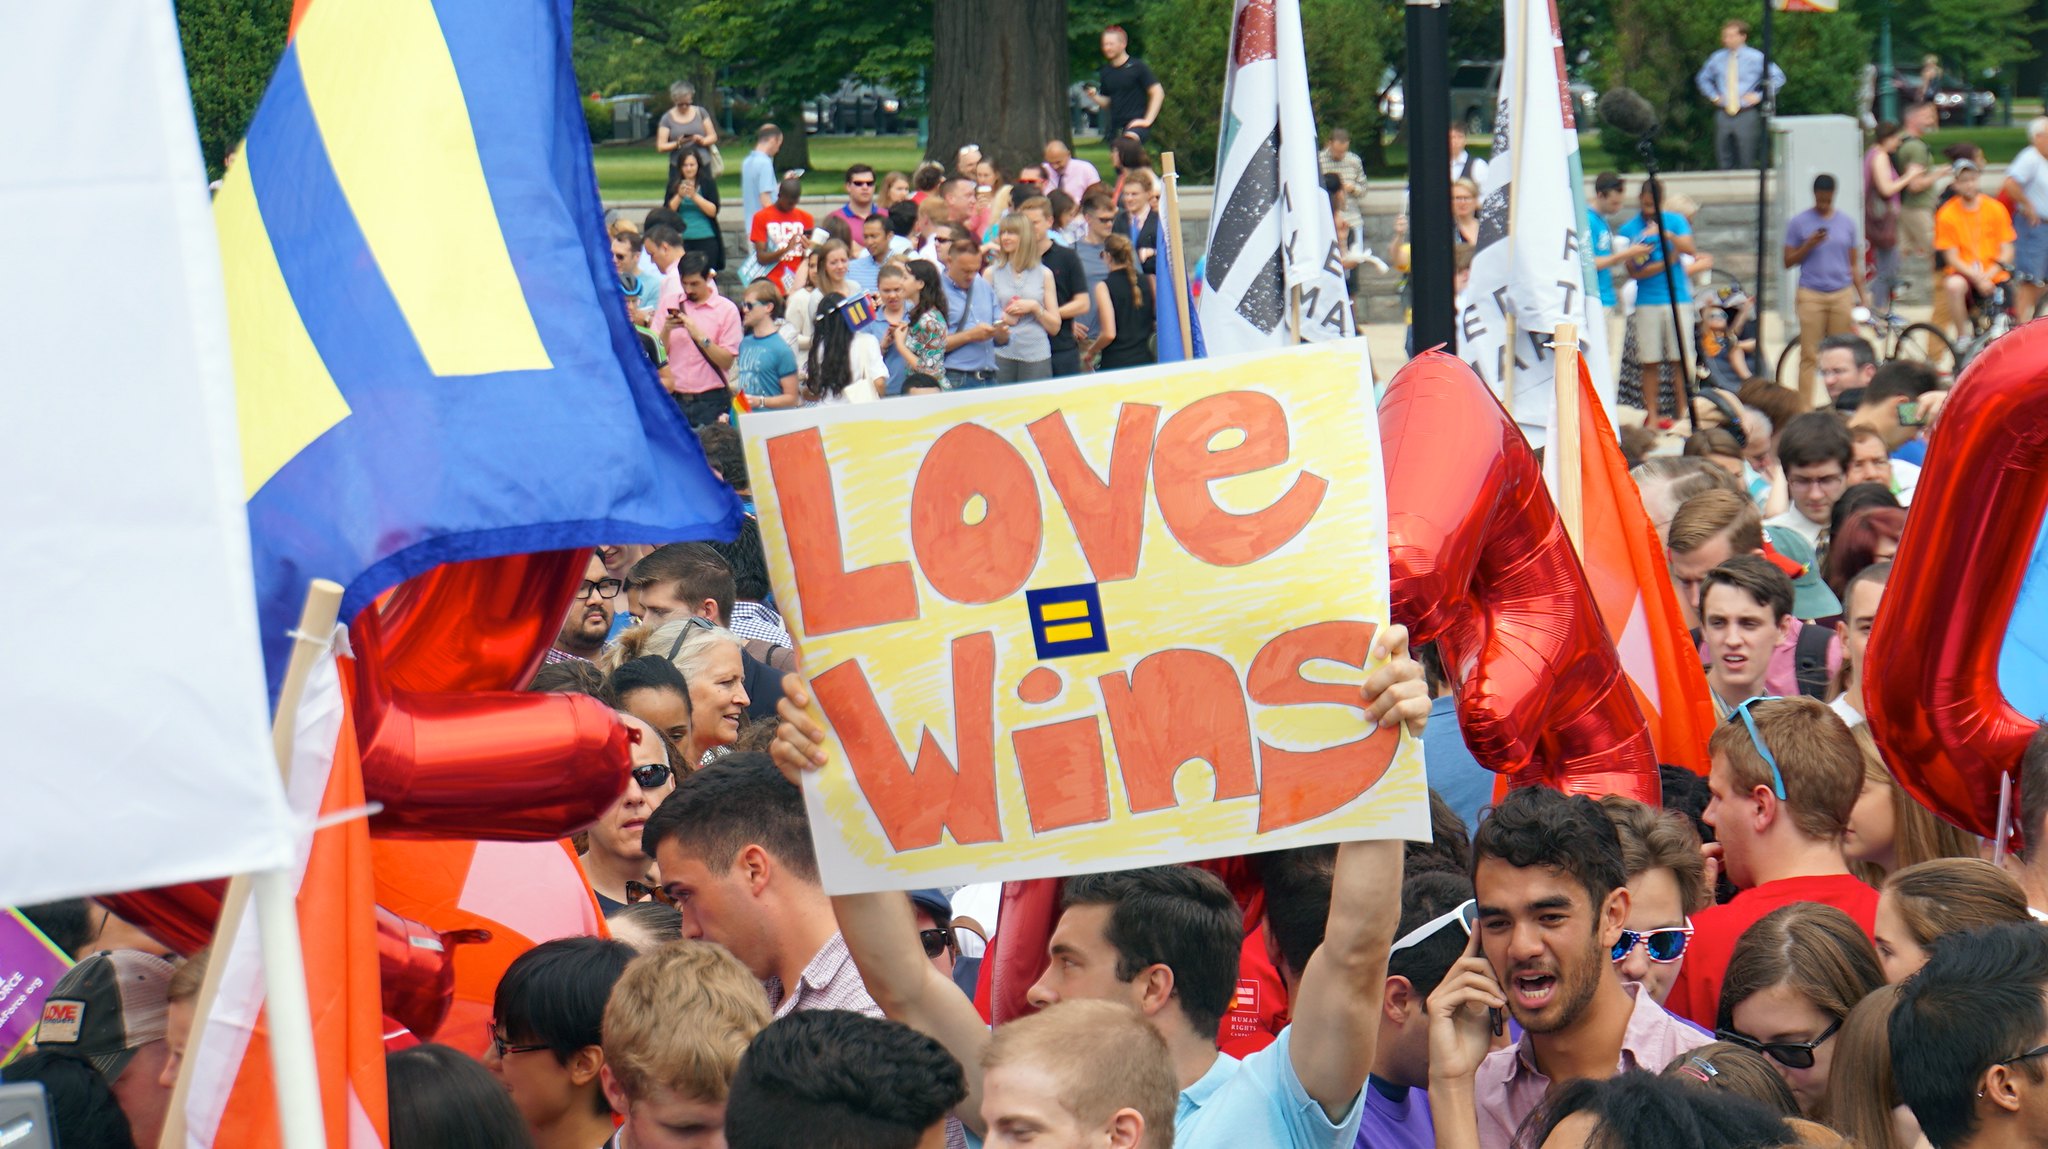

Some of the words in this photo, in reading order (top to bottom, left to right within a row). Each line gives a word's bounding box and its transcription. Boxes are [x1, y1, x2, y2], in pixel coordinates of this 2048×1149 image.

[765, 389, 1329, 637] Love
[809, 620, 1401, 855] Wins
[45, 1005, 78, 1020] LOVE
